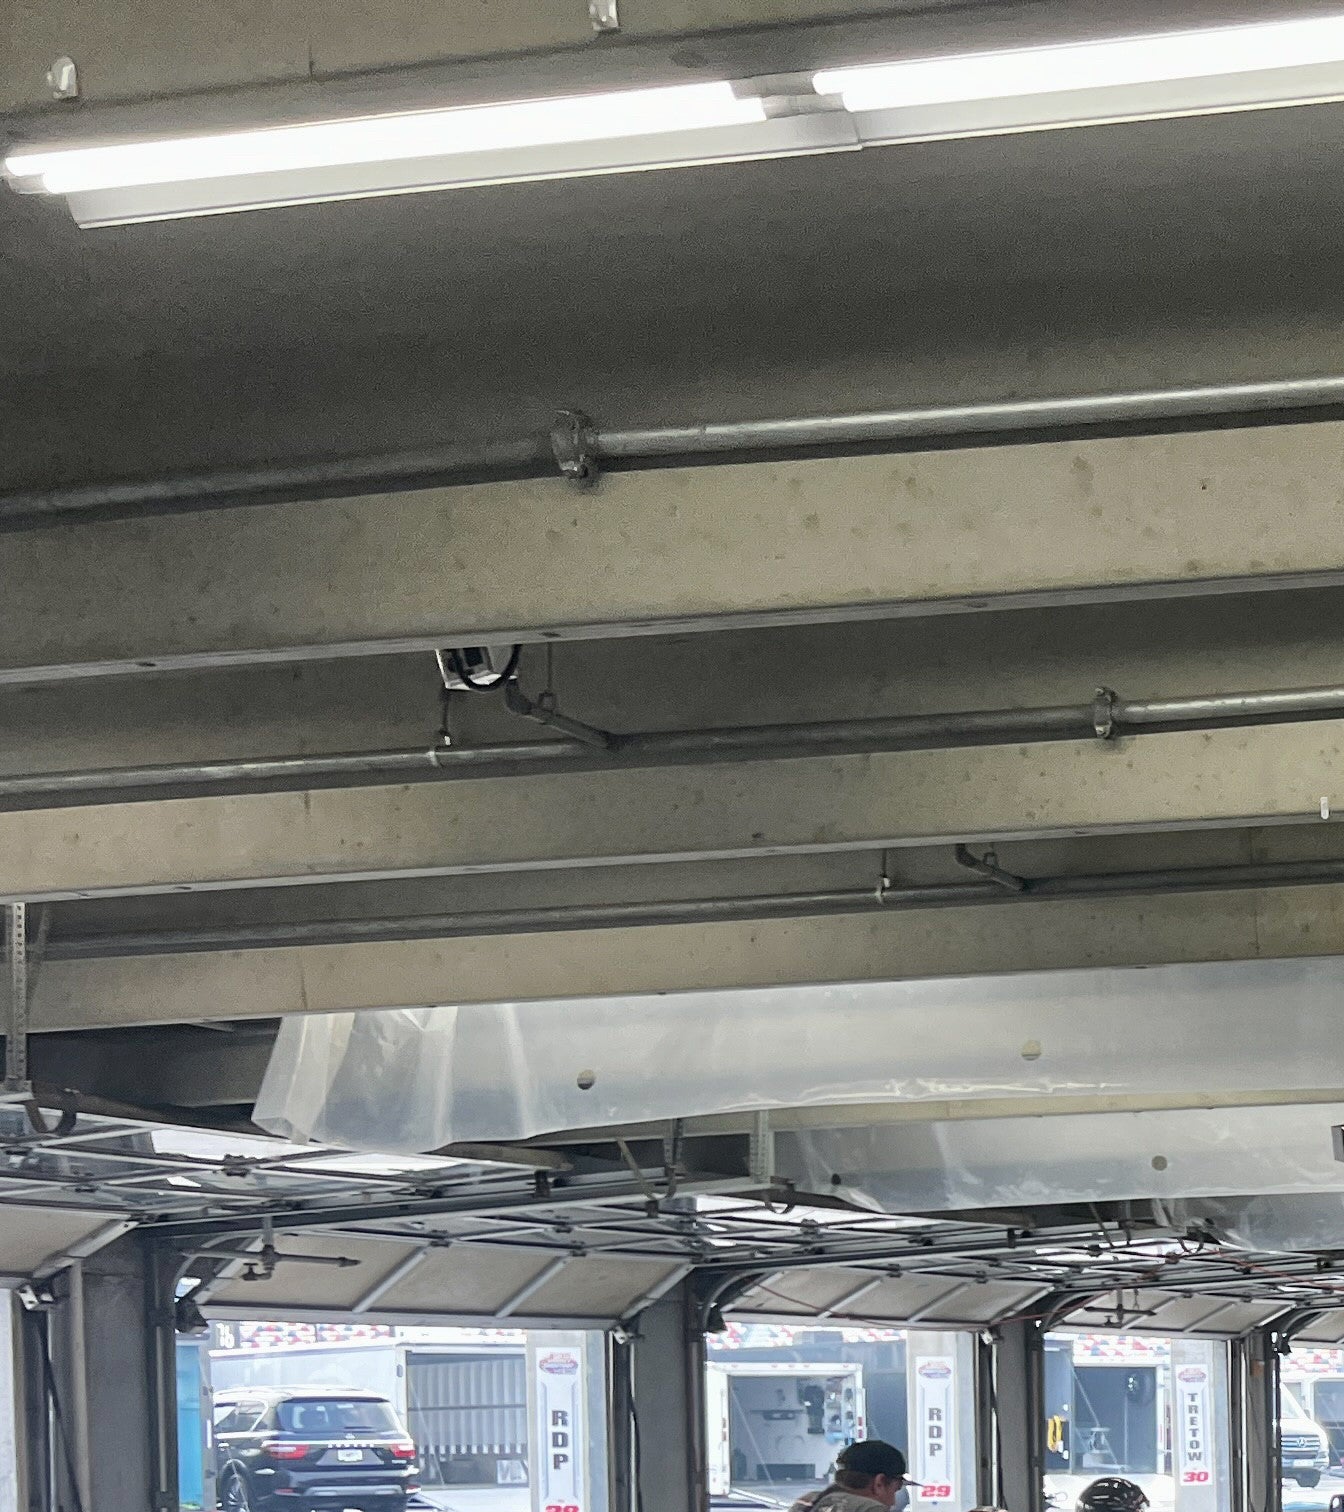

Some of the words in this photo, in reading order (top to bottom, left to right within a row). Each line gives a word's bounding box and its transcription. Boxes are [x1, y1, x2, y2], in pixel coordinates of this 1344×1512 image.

[552, 1409, 569, 1470] RDP
[928, 1407, 942, 1457] RDP
[1187, 1392, 1202, 1461] TRETOW
[921, 1485, 951, 1498] 29
[1183, 1471, 1209, 1483] 30
